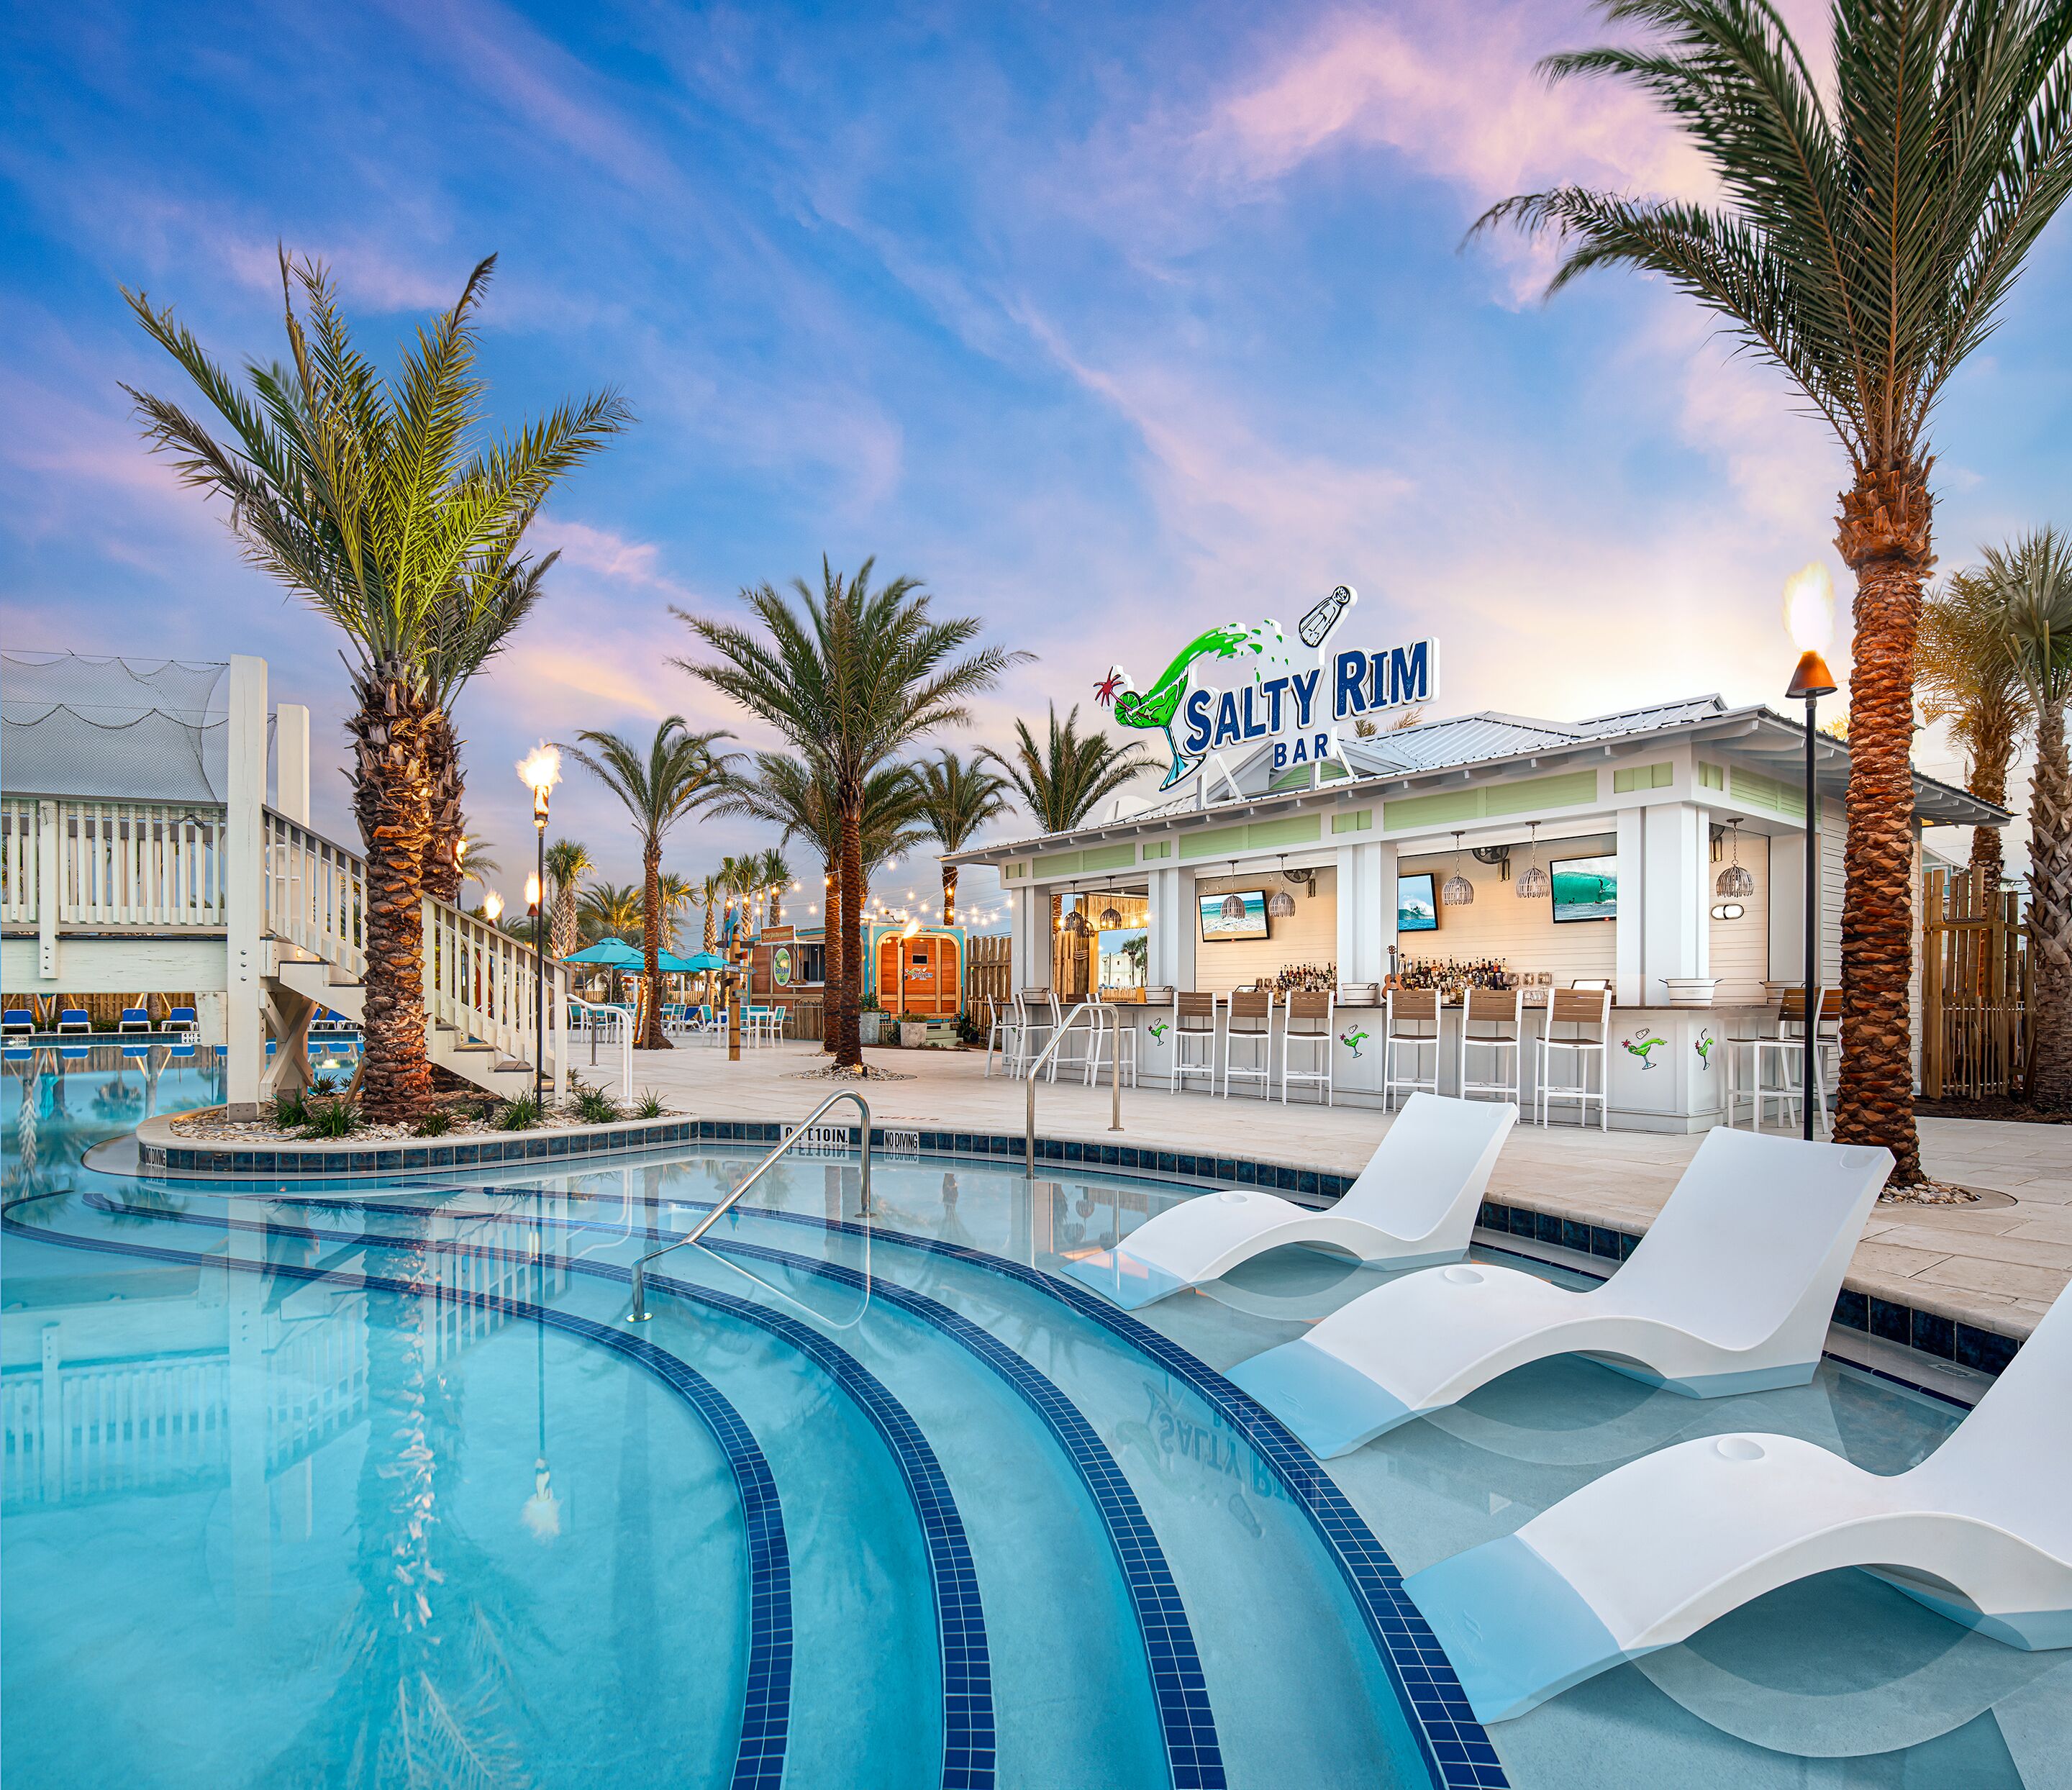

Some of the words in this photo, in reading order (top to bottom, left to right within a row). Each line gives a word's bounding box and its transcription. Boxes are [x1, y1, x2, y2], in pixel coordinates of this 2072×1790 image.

[1186, 668, 1321, 752] SALTY
[1335, 641, 1428, 717] RIM
[1274, 733, 1329, 769] BAR
[885, 1132, 894, 1147] NO
[895, 1132, 918, 1148] DIVING
